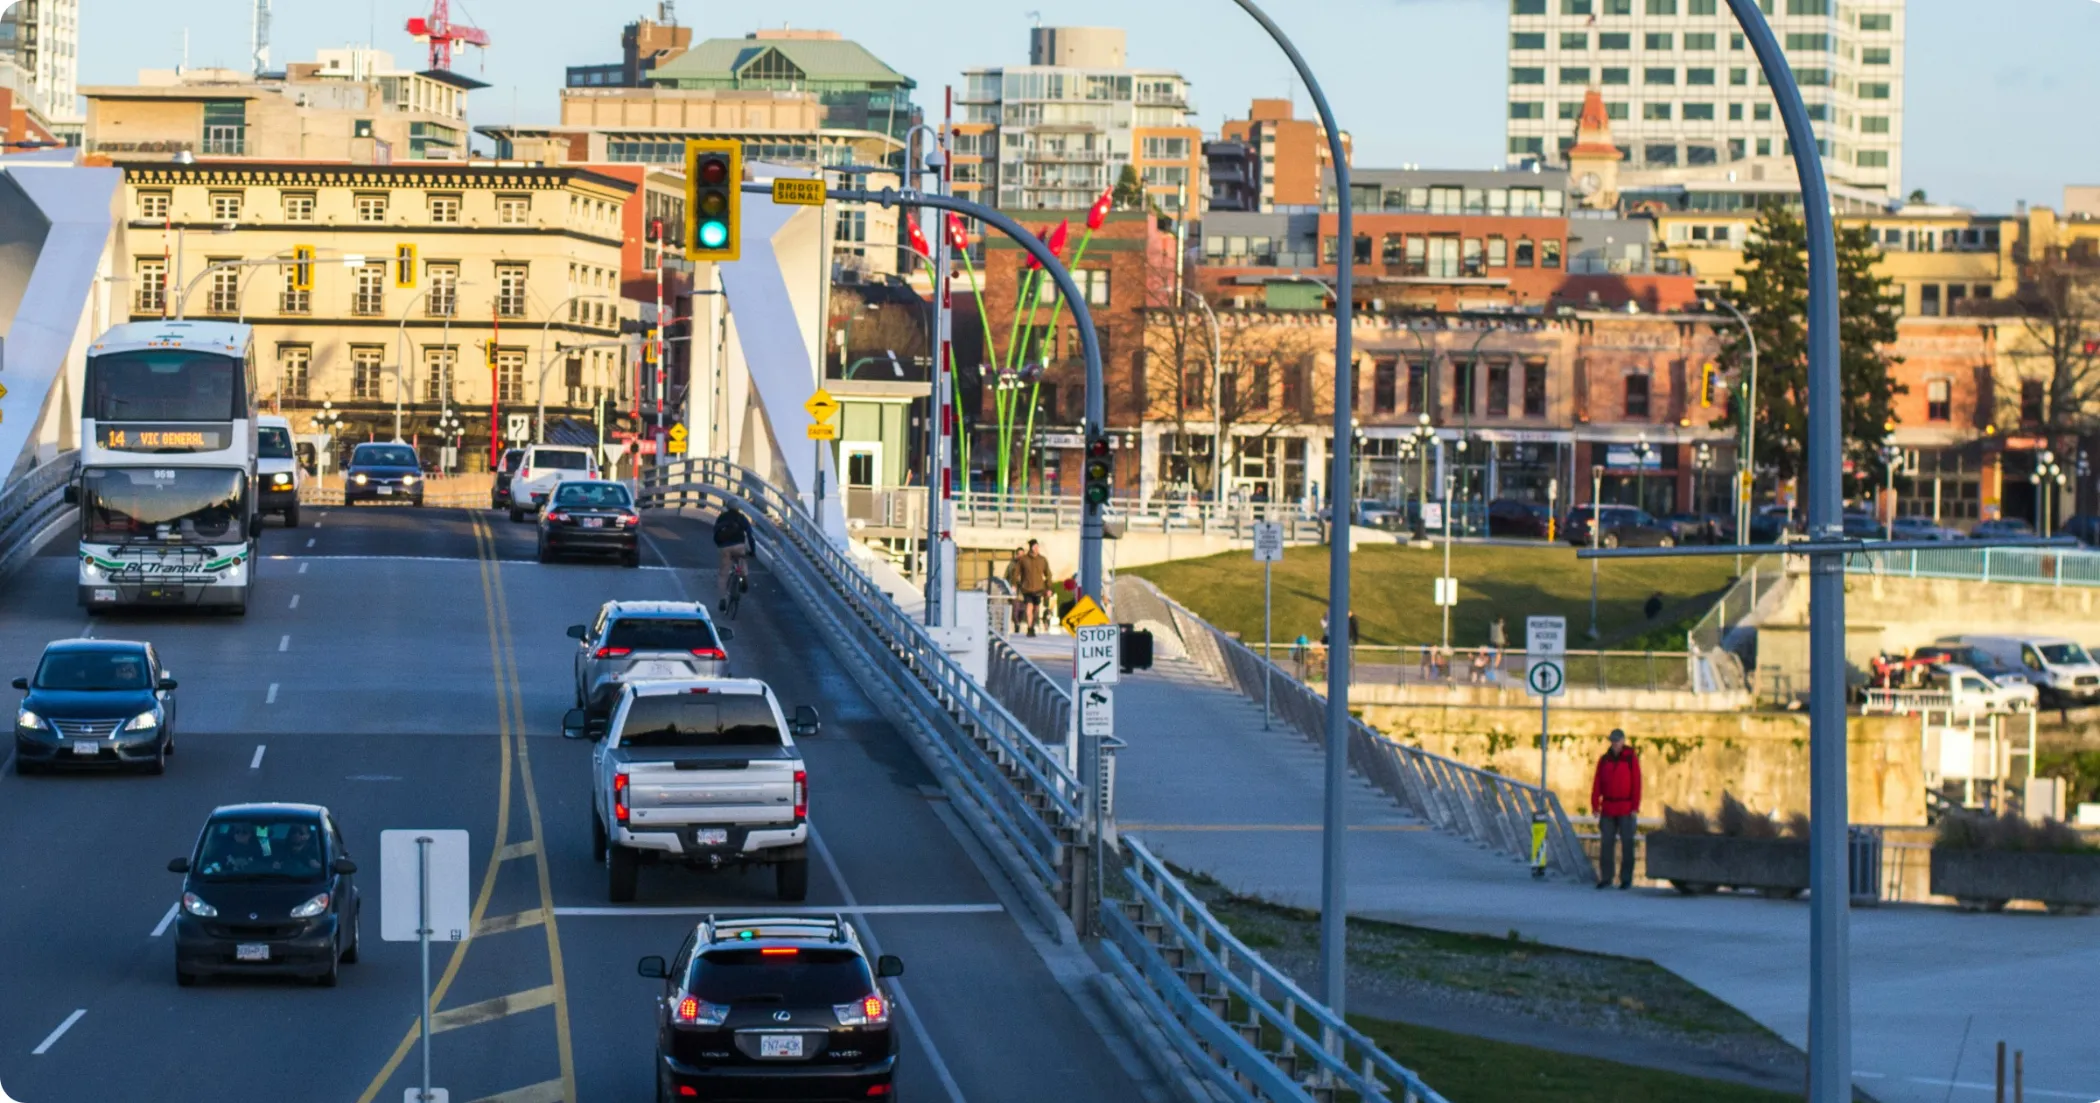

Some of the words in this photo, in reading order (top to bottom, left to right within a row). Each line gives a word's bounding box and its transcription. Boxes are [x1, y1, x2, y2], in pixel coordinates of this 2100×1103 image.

[778, 183, 821, 192] BRIDGE
[778, 192, 821, 201] SIGNAL
[108, 430, 126, 447] 14
[140, 432, 159, 446] VIC
[162, 431, 205, 446] GENERAL
[1080, 629, 1116, 642] STOP
[1082, 645, 1114, 658] LINE
